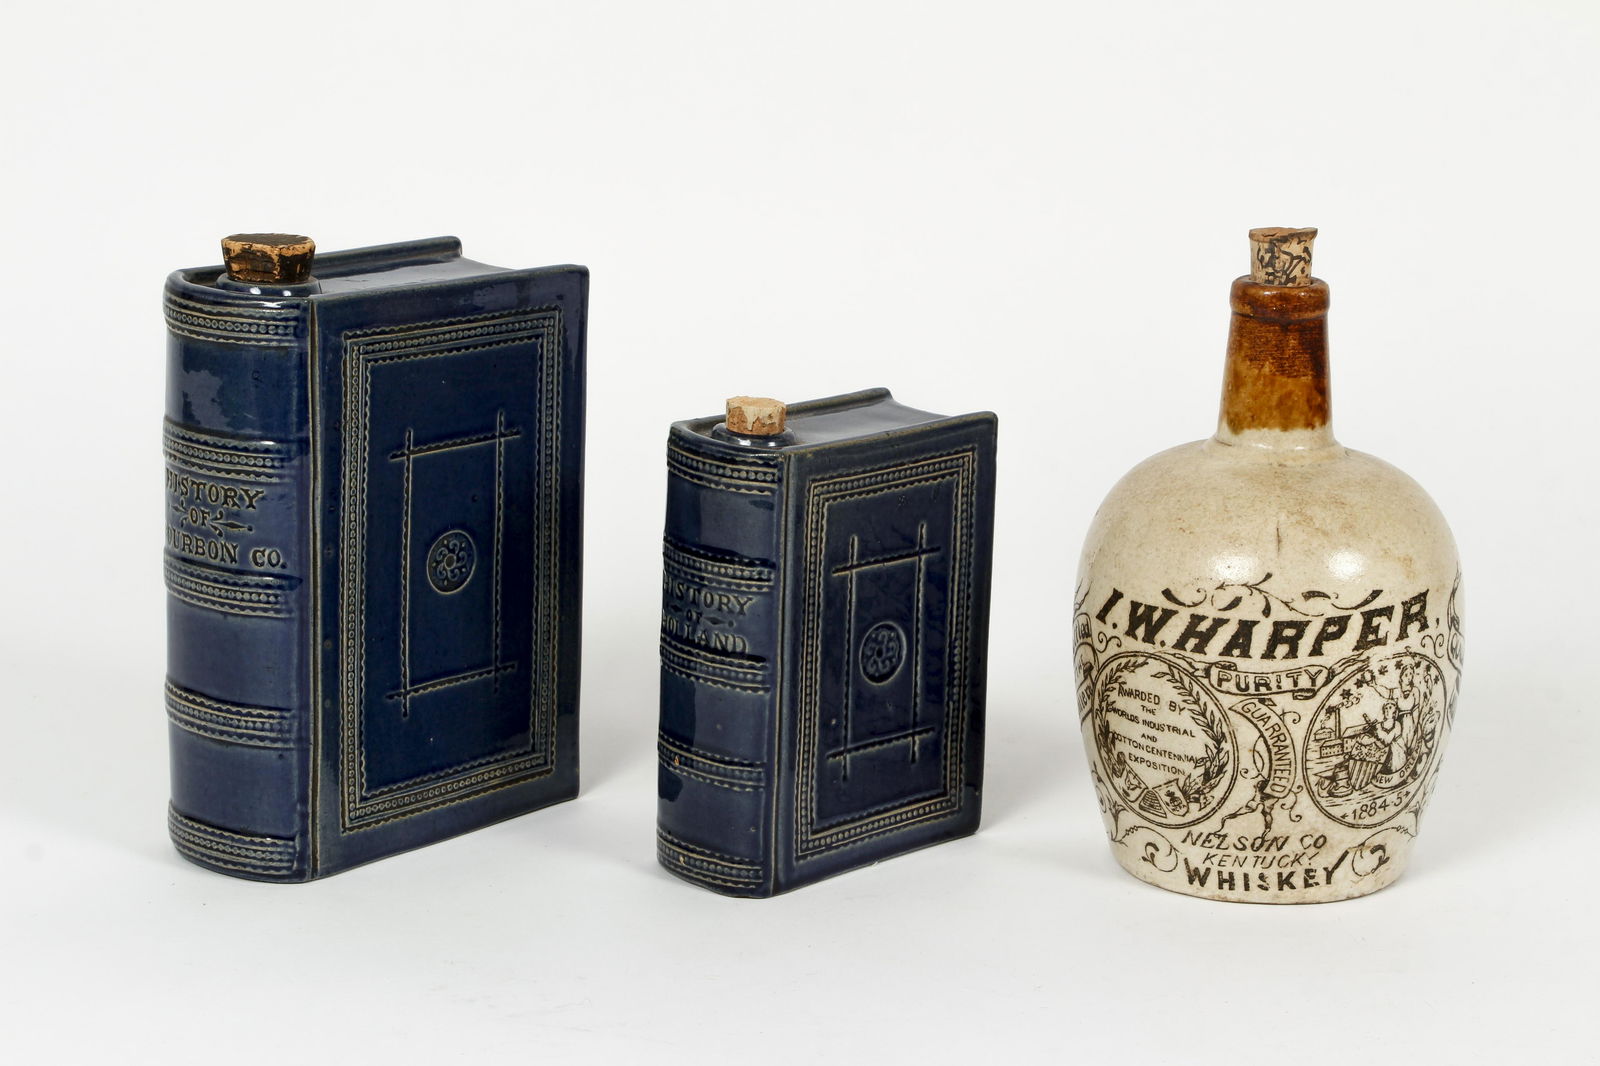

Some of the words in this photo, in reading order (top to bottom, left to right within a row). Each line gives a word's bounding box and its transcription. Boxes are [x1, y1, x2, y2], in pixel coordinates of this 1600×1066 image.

[165, 468, 265, 510] HISTORY
[189, 507, 211, 527] OF
[251, 548, 288, 569] CO.
[686, 608, 703, 624] OF
[1216, 669, 1323, 692] PURITY
[1117, 685, 1161, 705] AWARDED
[1168, 700, 1186, 715] BY
[1140, 704, 1157, 716] THE
[1140, 733, 1158, 743] AND
[1142, 719, 1196, 738] INDUSTRIAL
[1241, 701, 1291, 794] GUARRANTEED
[1128, 752, 1186, 776] EXPOSITION
[1181, 830, 1290, 853] NELSON
[1299, 833, 1328, 850] CO
[1183, 850, 1350, 891] WHISKEY
[1202, 851, 1319, 869] KENTUCKY
